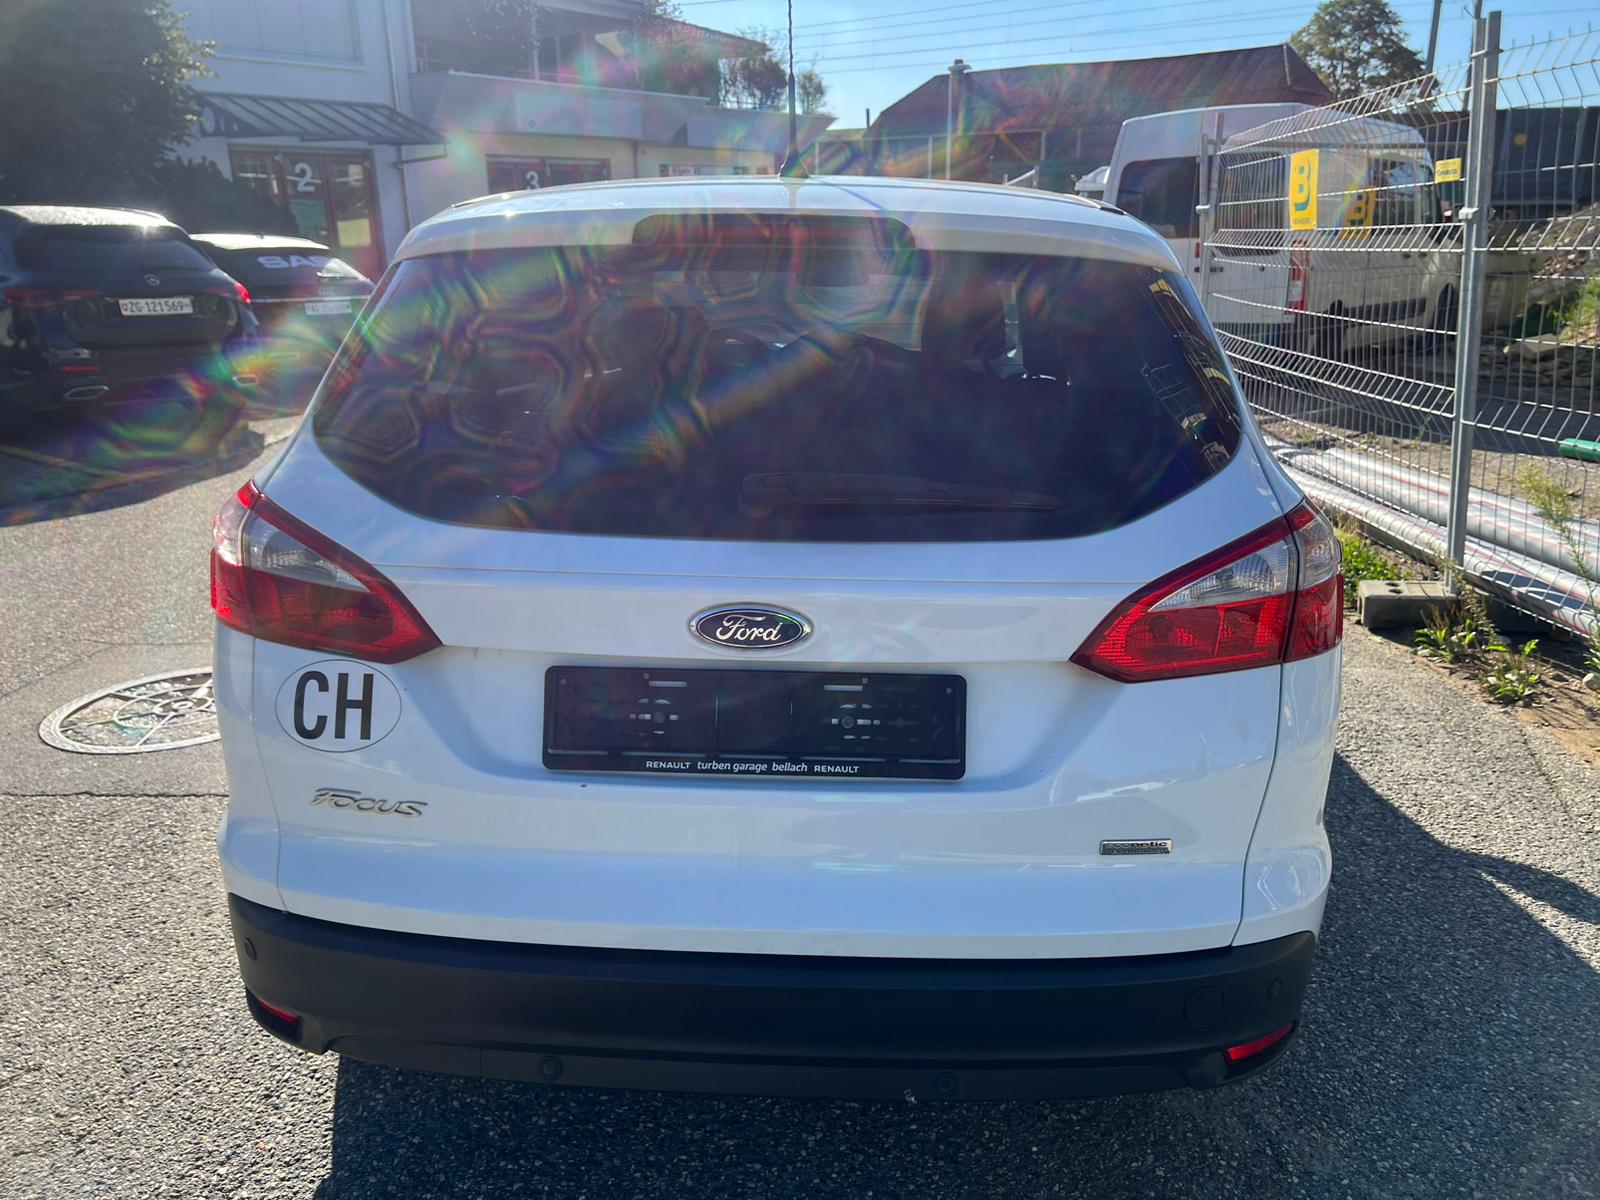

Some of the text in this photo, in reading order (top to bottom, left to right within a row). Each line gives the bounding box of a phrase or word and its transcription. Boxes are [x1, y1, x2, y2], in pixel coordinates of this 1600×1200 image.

[294, 162, 315, 192] 2
[526, 170, 540, 190] 3
[715, 614, 783, 643] Ford
[294, 670, 374, 741] CH
[646, 760, 860, 774] RENAULT turben garage bellach RENAULT
